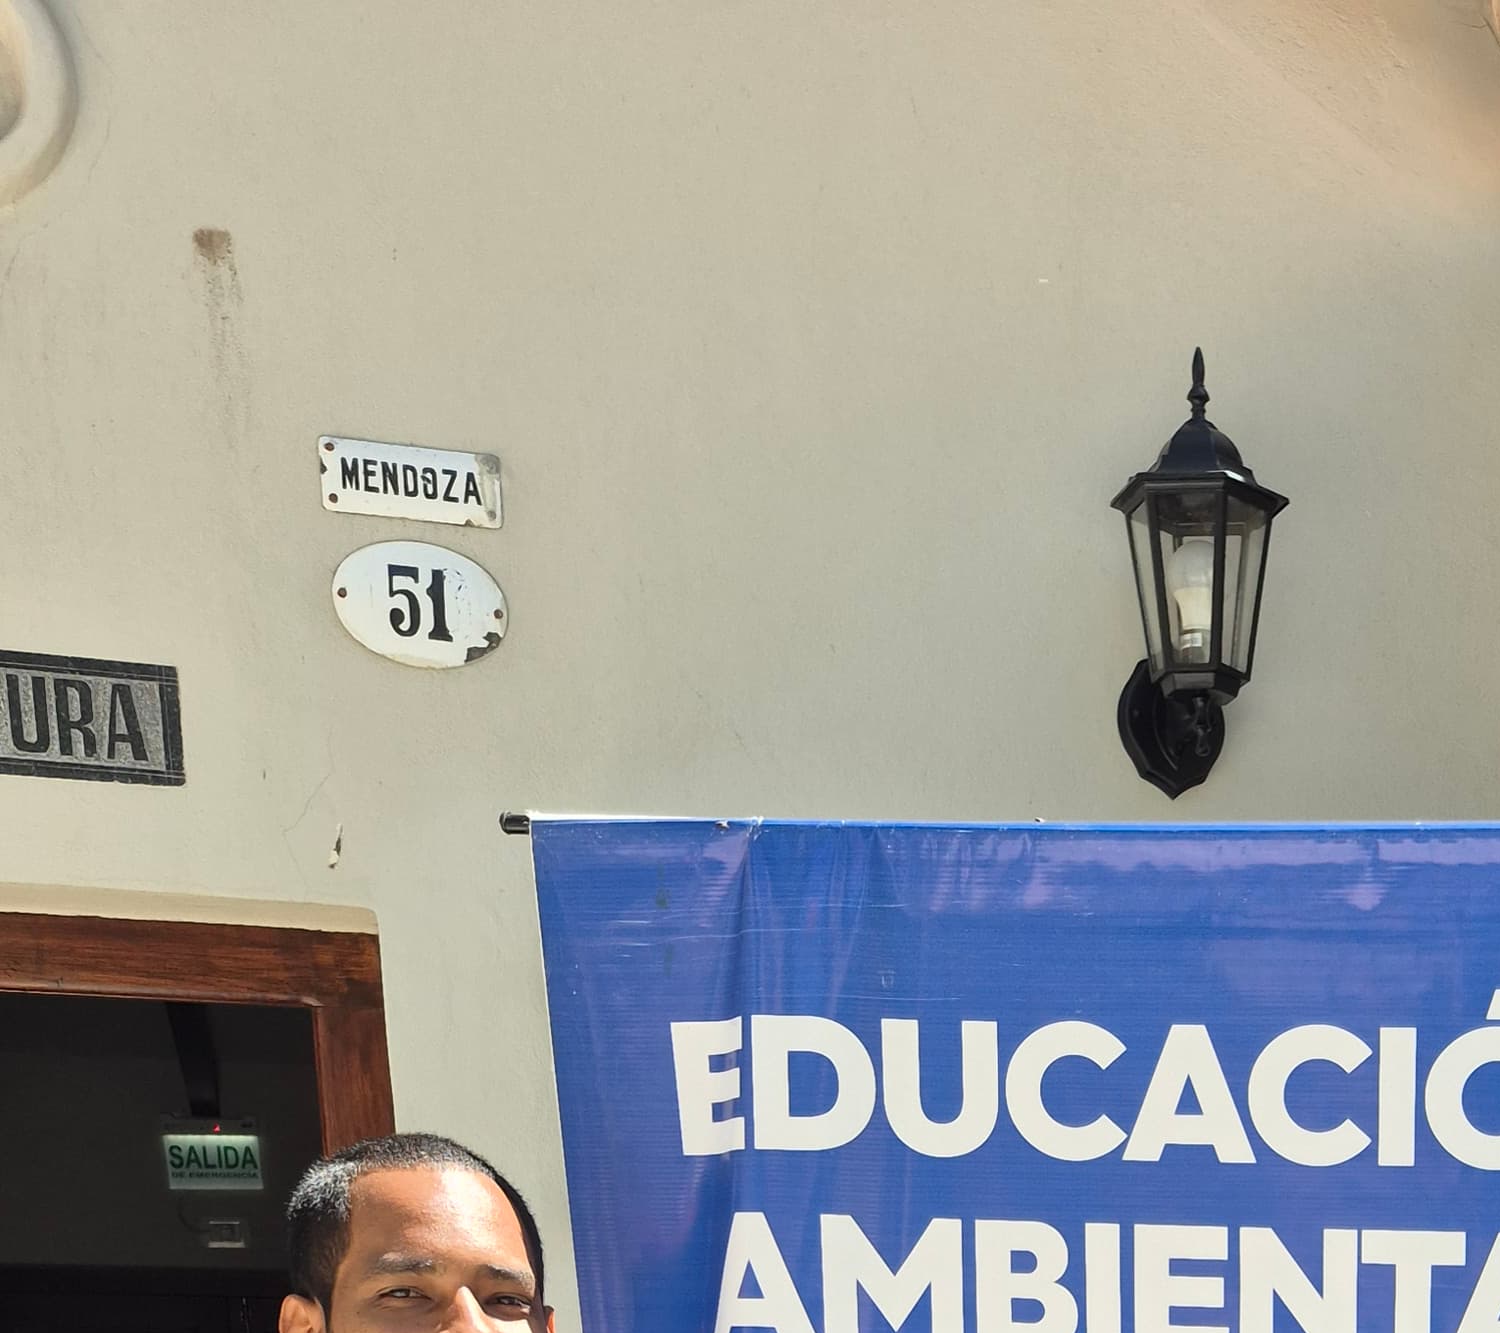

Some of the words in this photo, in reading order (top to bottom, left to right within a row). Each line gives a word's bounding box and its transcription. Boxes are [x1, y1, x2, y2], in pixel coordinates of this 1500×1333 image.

[340, 457, 482, 506] MENDOZA
[387, 564, 453, 642] 51
[168, 1145, 258, 1169] SALIDA
